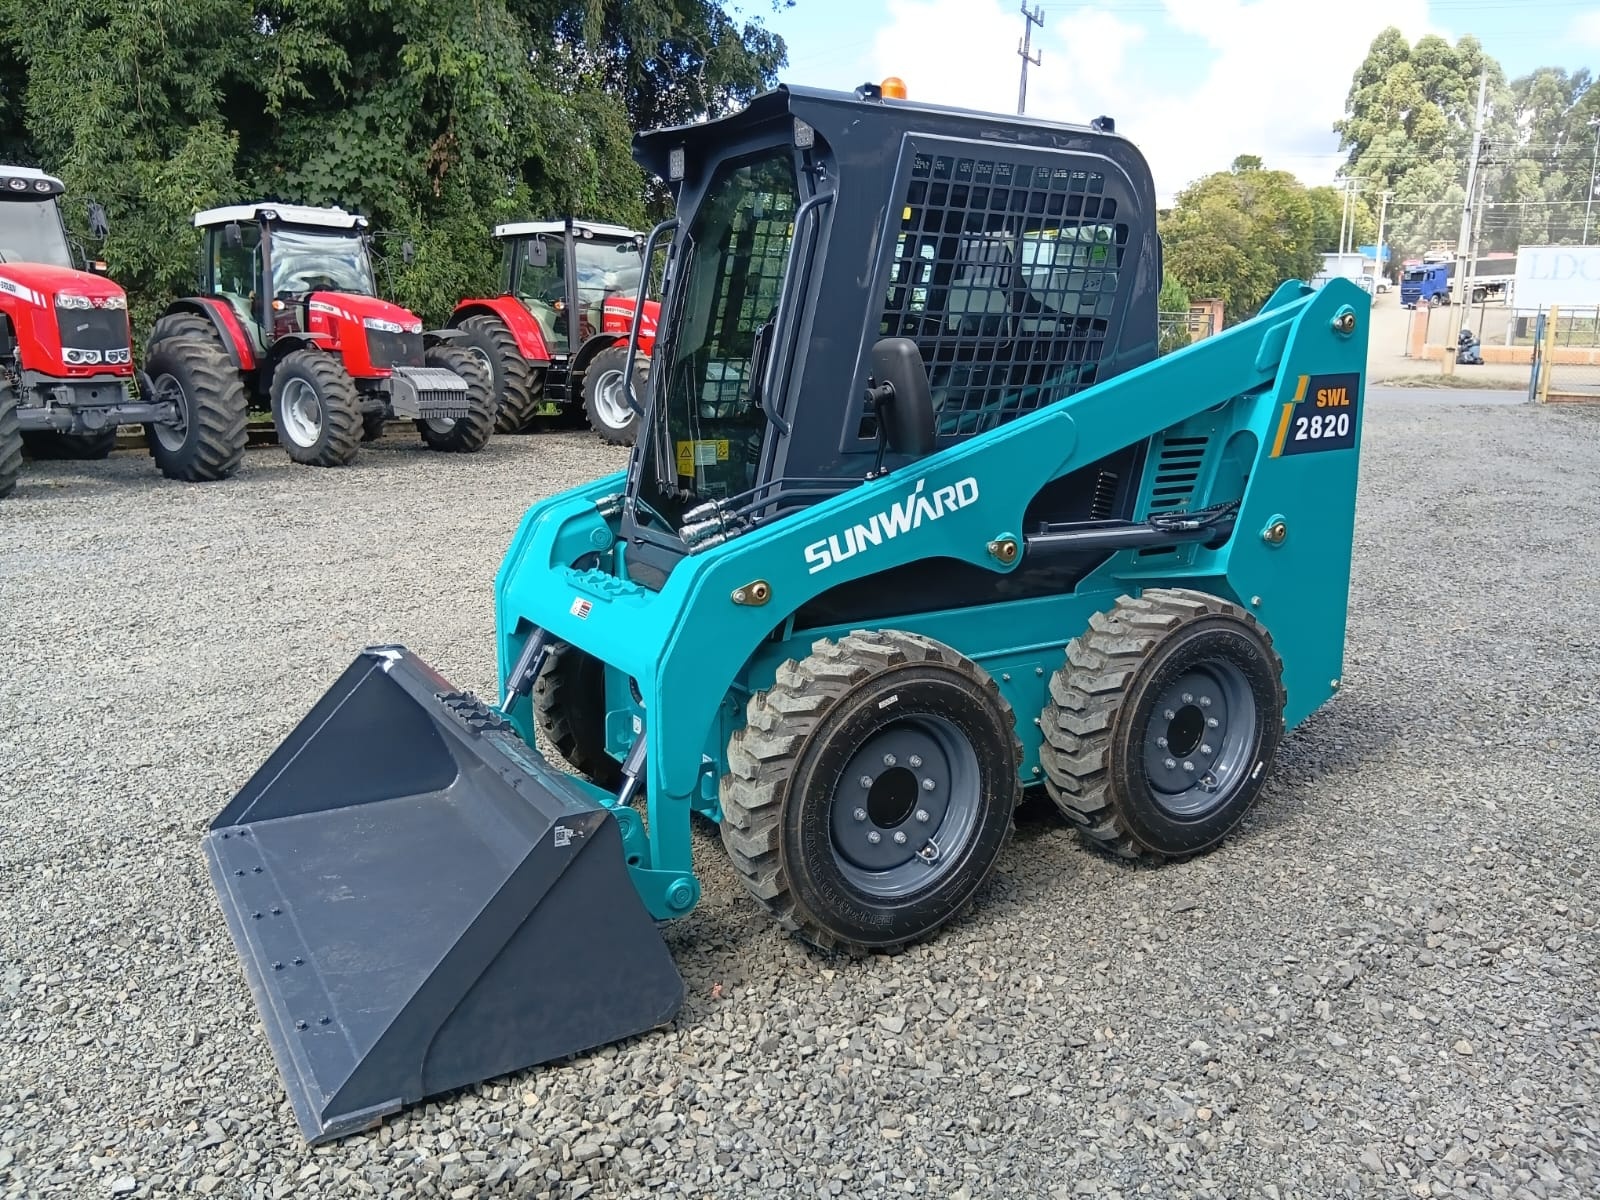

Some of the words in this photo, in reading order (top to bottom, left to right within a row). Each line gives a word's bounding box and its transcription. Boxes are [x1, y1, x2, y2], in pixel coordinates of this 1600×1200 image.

[1316, 388, 1350, 407] SWL
[1294, 413, 1350, 441] 2820
[804, 477, 980, 575] SUNWARD
